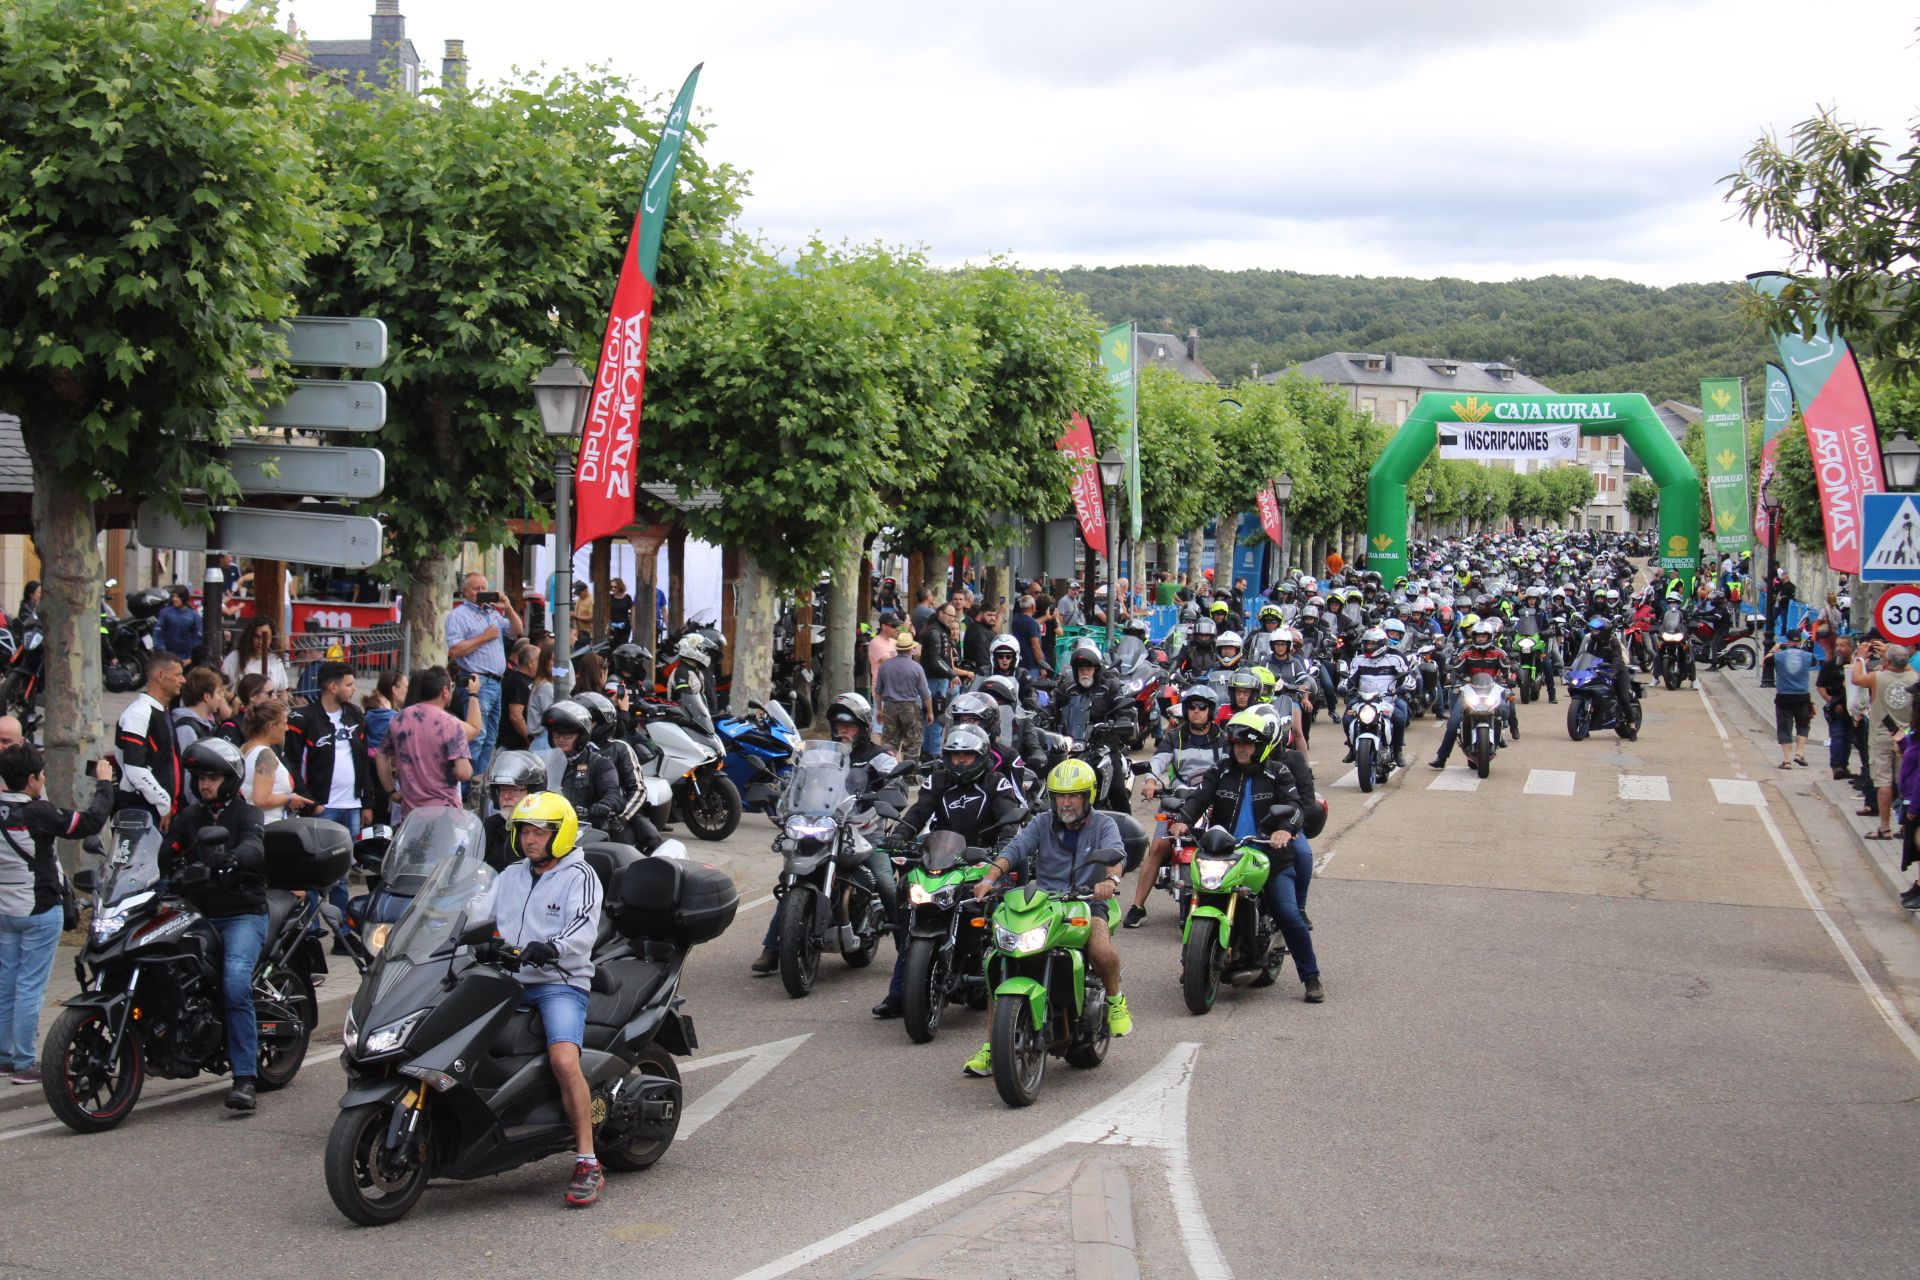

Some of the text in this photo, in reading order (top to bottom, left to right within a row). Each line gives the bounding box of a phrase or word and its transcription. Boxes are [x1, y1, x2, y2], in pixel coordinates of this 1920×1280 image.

[606, 309, 646, 499] ZAMORA
[1494, 402, 1616, 420] CAJA RURAL
[1464, 430, 1549, 451] INSCRIPCIONES
[1887, 605, 1920, 625] 30
